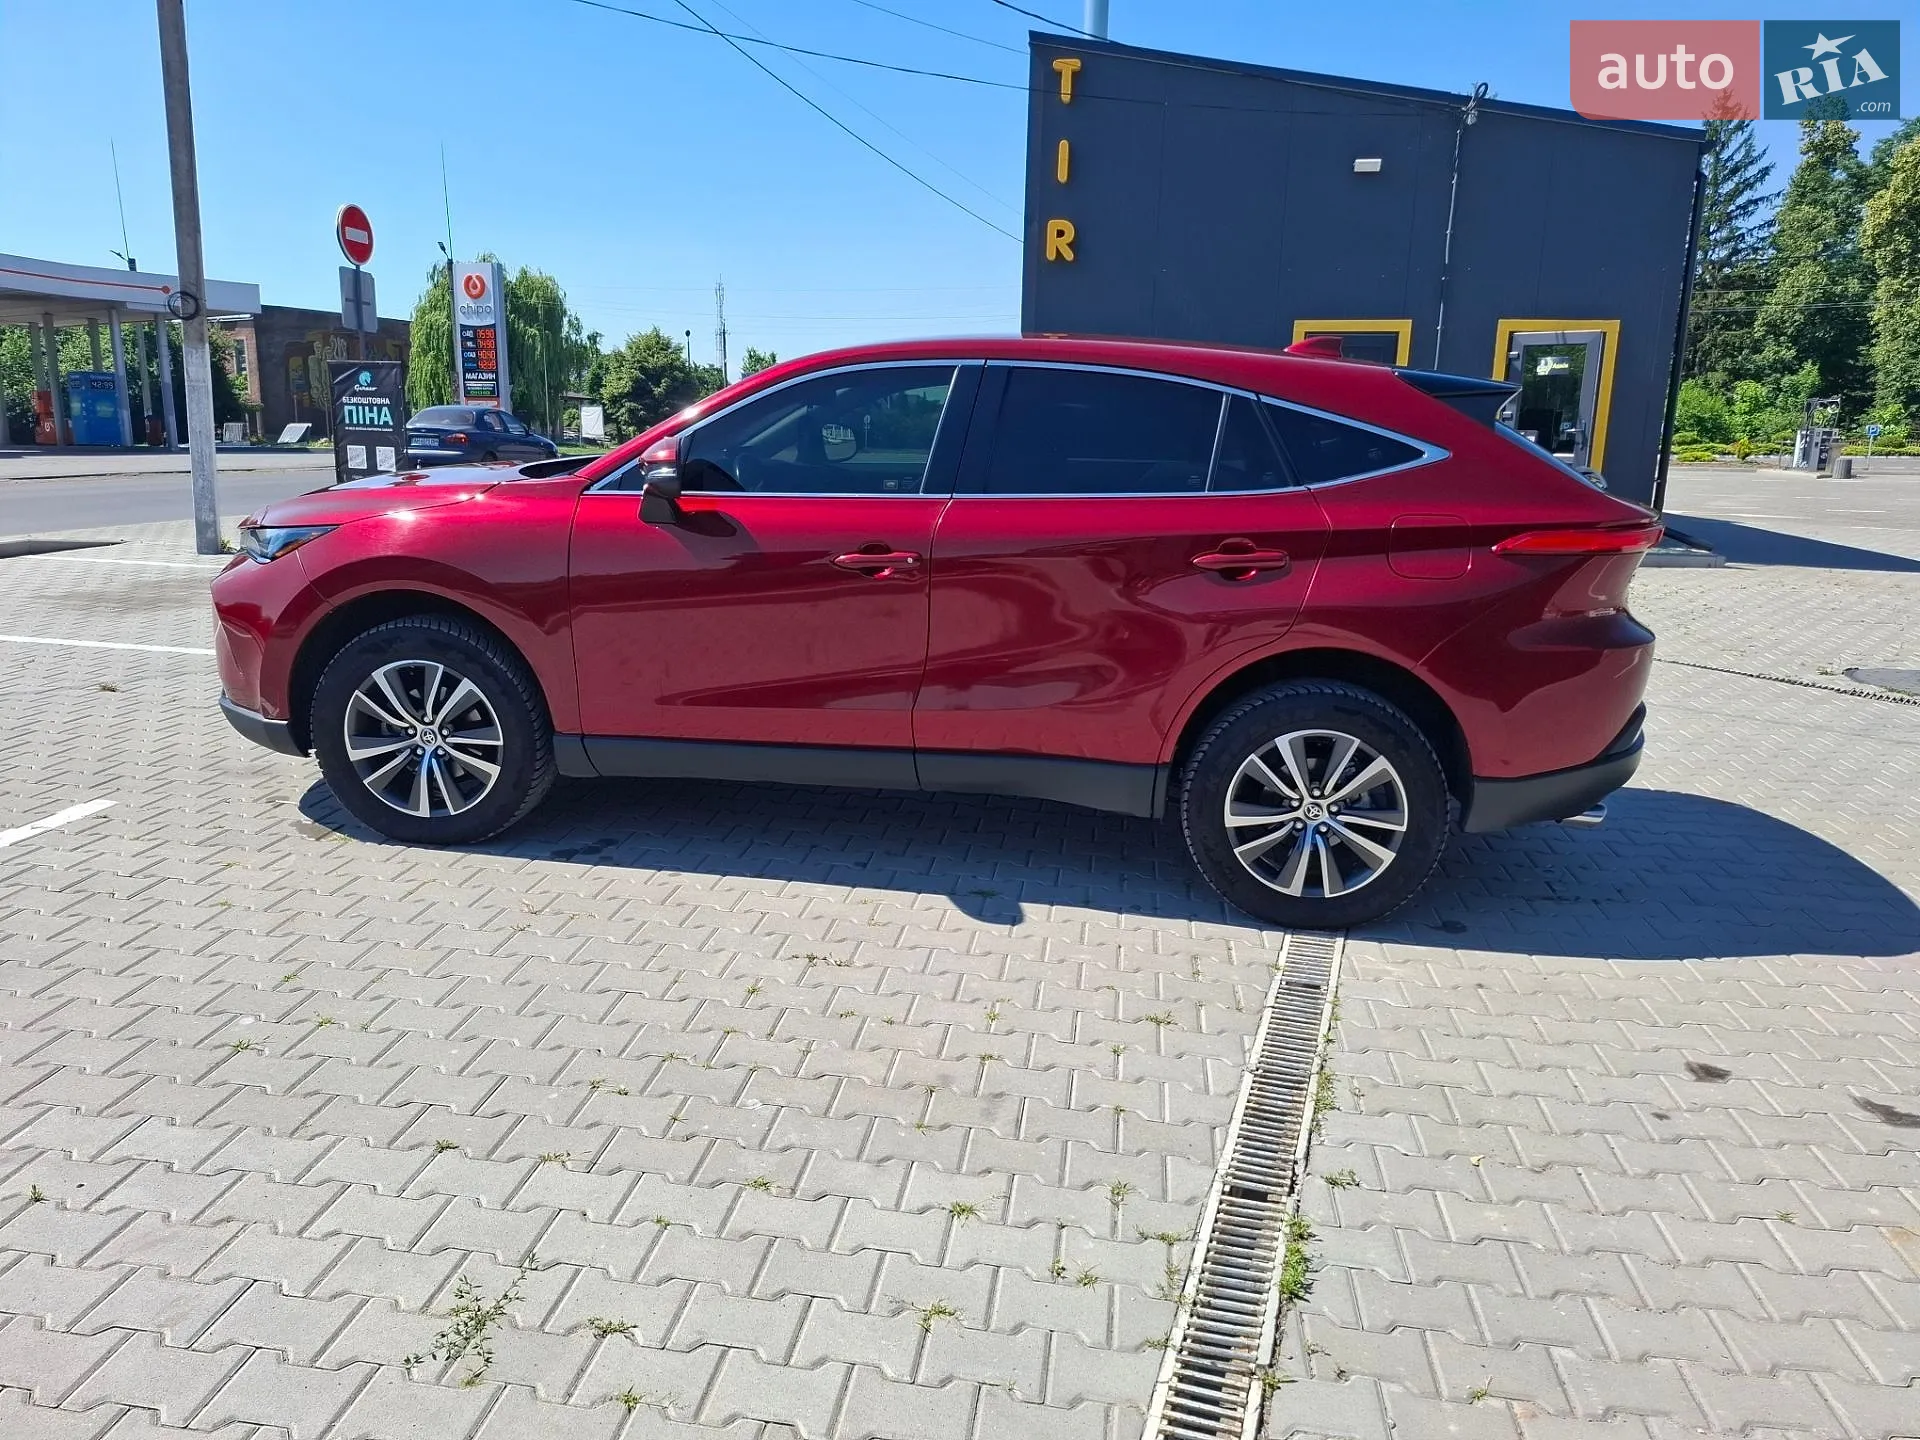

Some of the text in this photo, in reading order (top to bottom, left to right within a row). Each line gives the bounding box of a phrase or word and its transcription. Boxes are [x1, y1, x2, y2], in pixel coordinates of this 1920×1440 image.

[460, 303, 493, 316] chipo
[342, 396, 391, 404] БЕЗКОШТОВНА
[344, 405, 393, 426] ПІНА
